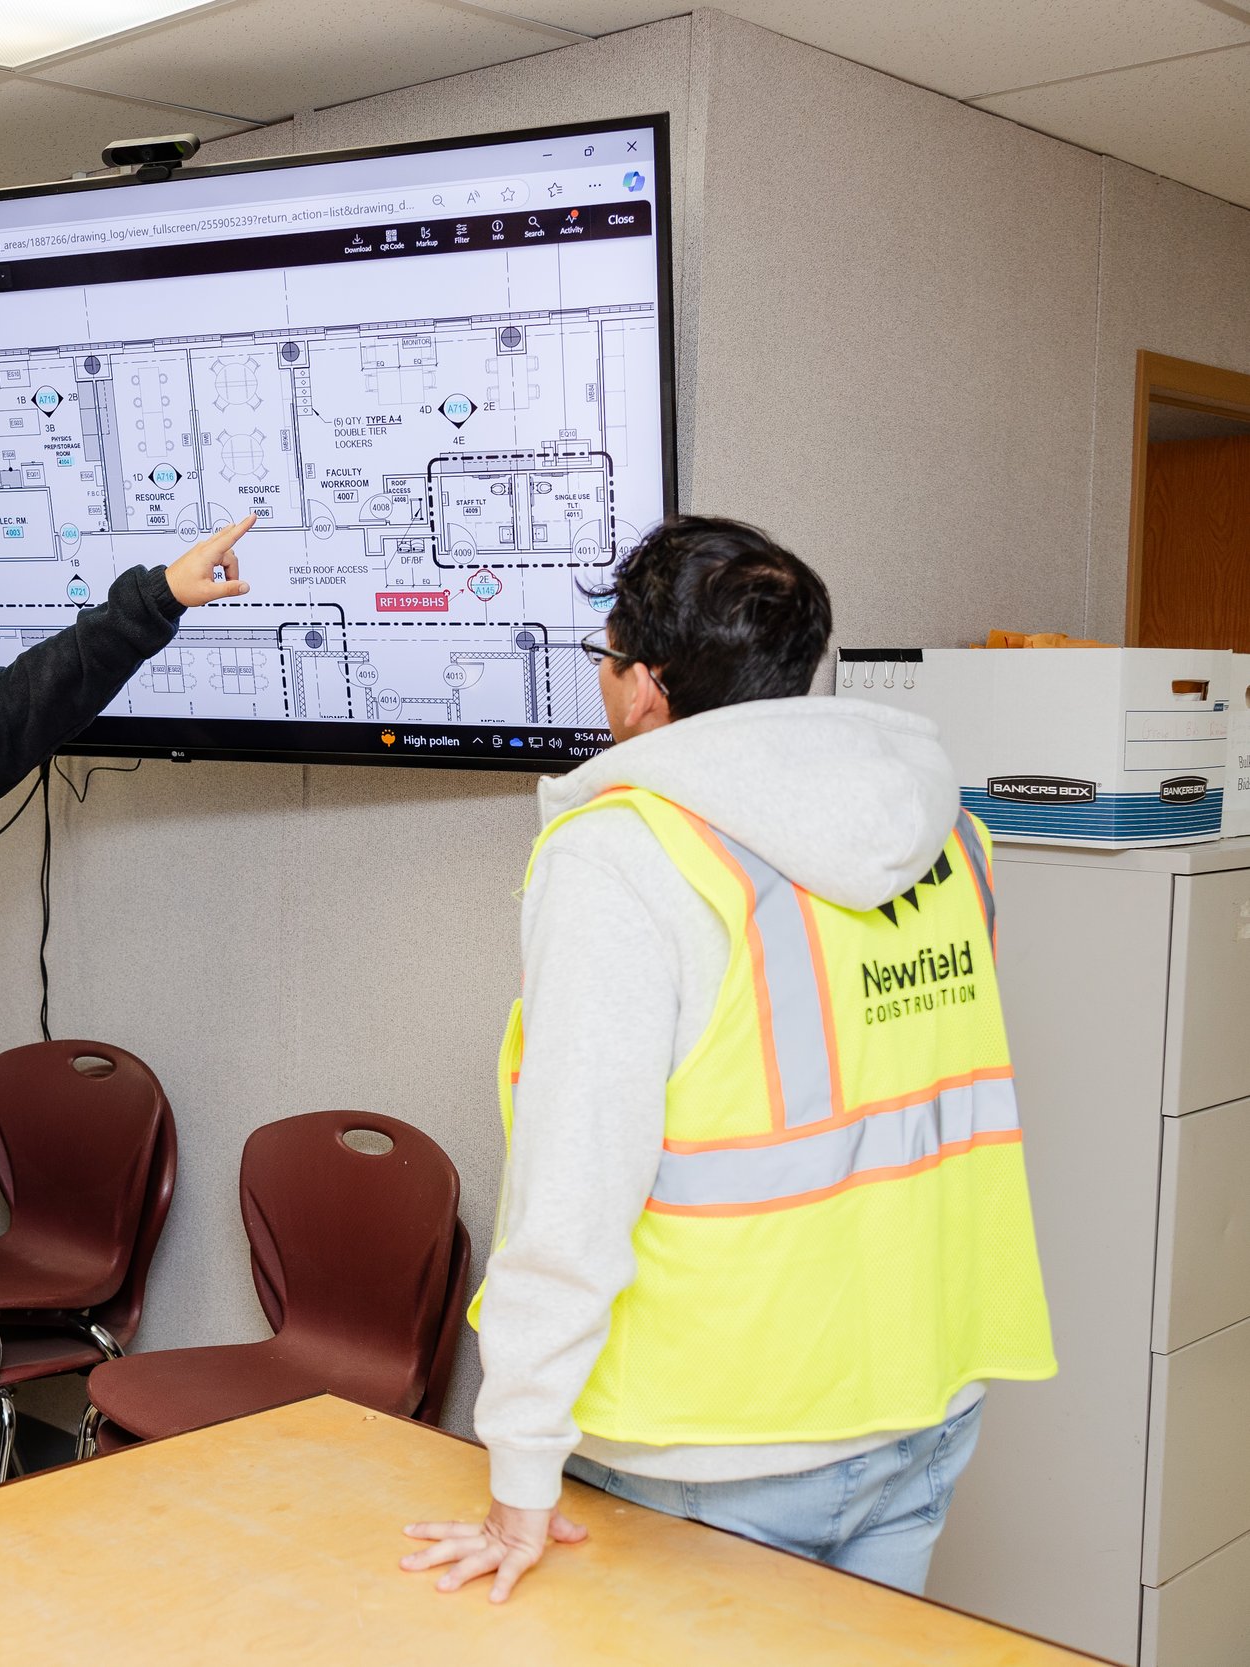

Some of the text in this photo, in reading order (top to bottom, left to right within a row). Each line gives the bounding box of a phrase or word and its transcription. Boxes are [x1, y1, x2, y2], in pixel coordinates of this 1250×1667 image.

[608, 214, 635, 226] Close
[524, 228, 545, 238] Search
[560, 225, 584, 236] Activity
[454, 235, 470, 244] Filter
[492, 232, 505, 241] Info
[380, 242, 405, 251] QR Code
[416, 239, 439, 248] Markup
[344, 244, 372, 255] Download
[402, 337, 431, 347] MONITOR
[17, 396, 27, 405] 1B
[38, 394, 56, 405] A716
[68, 393, 79, 402] 2B
[419, 405, 432, 414] 4D
[447, 403, 468, 413] A715
[483, 402, 496, 411] 2E
[333, 417, 344, 427] (5)
[366, 415, 387, 424] TYPE
[388, 414, 403, 423] A-4
[45, 424, 55, 433] 3B
[334, 426, 387, 437] DOUBLE TIER
[335, 439, 373, 449] LOCKERS
[452, 436, 466, 445] 4E
[186, 471, 198, 480] 2D
[326, 468, 362, 477] FACULTY
[132, 473, 144, 482] 1D
[156, 473, 174, 482] A716
[320, 479, 370, 488] WORKROOM
[238, 485, 281, 494] RESOURCE
[135, 493, 175, 502] RESOURCE
[253, 496, 267, 505] RM.
[337, 492, 354, 501] 4007
[149, 504, 163, 512] RM.
[372, 502, 390, 511] 4008
[15, 515, 29, 525] RM.
[149, 515, 166, 524] 4005
[5, 528, 21, 537] 4003
[180, 527, 197, 536] 4005
[314, 524, 332, 533] 4007
[62, 529, 77, 538] 4004
[453, 548, 472, 557] 4009
[577, 546, 596, 555] 4011
[70, 559, 80, 567] 1B
[400, 556, 424, 565] DF/BF
[289, 565, 369, 575] FIXED ROOF ACCESS
[290, 576, 347, 585] SHIP'S LADDER
[479, 575, 490, 584] 2E
[70, 587, 86, 597] A721
[475, 586, 495, 596] A145
[380, 597, 445, 607] RFI 199-BHS
[358, 670, 376, 680] 4015
[445, 671, 464, 681] 4013
[380, 695, 398, 705] 4014
[403, 735, 460, 748] High pollen
[574, 732, 613, 742] 9:54 AM
[993, 783, 1090, 796] BANKERS BOX
[1163, 784, 1205, 796] BANKERS BOX
[861, 940, 974, 998] Newfield
[865, 984, 976, 1025] COSTRUTION
